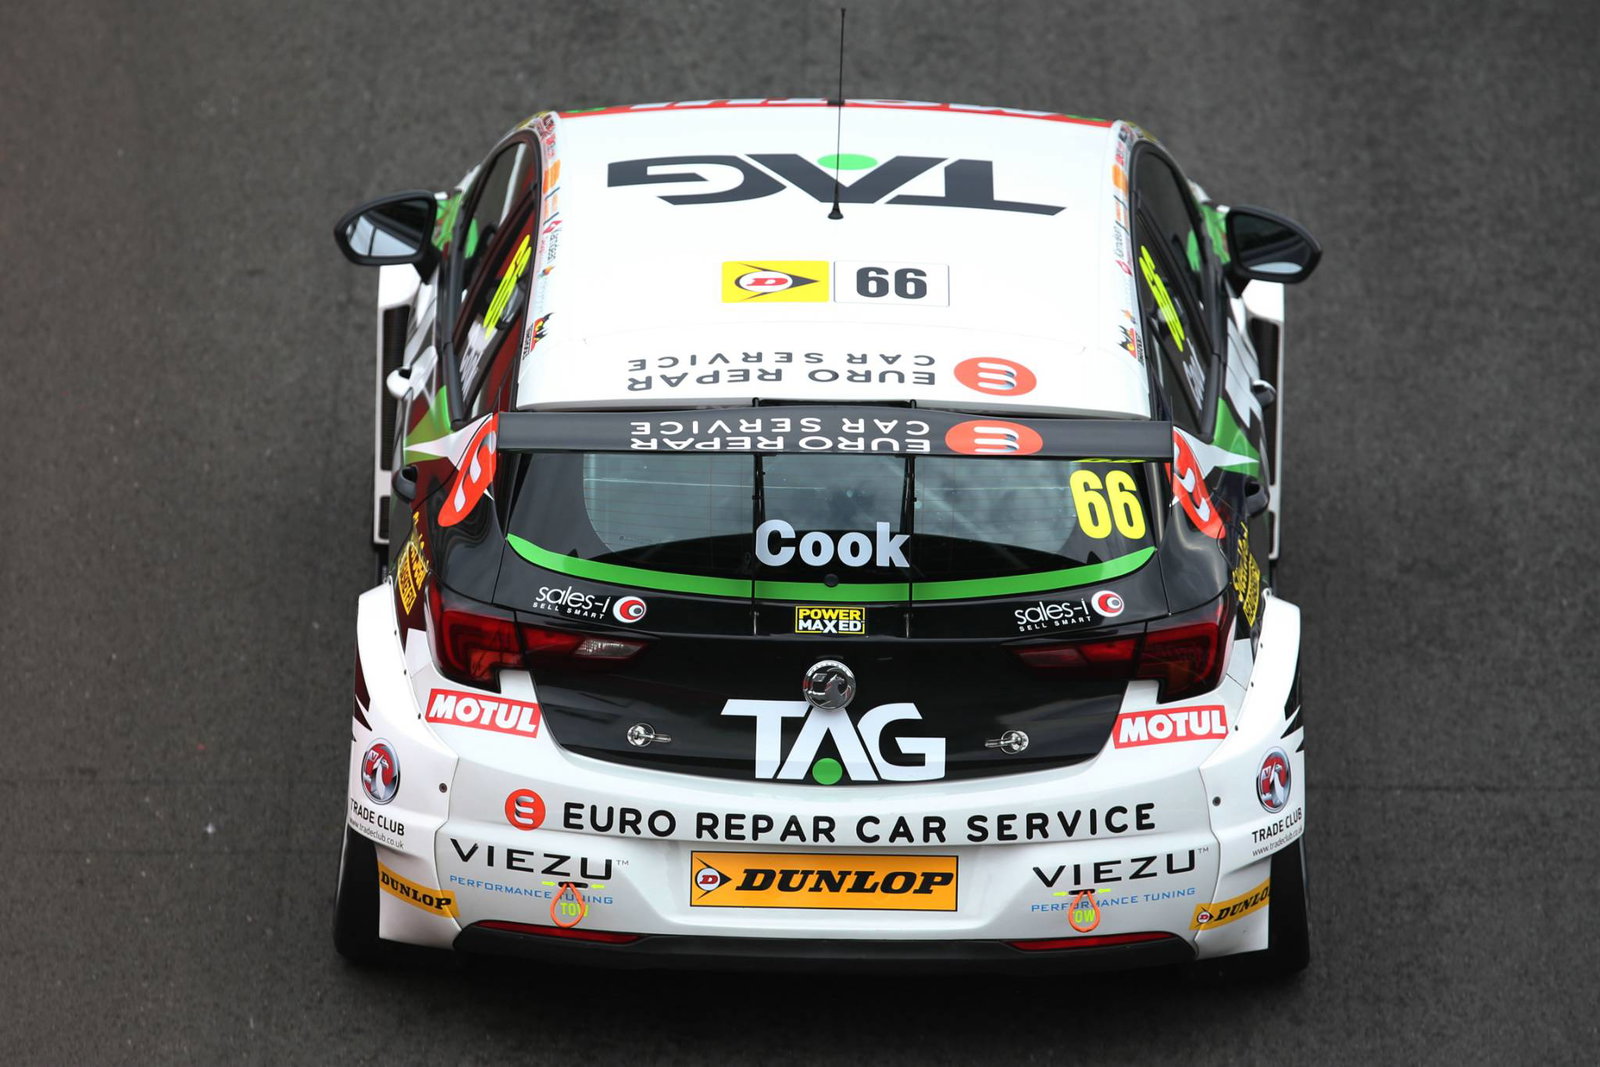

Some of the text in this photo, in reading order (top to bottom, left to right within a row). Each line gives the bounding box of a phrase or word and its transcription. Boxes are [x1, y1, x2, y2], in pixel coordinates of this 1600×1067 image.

[607, 153, 1067, 216] TAG
[856, 266, 928, 300] 66
[628, 350, 936, 371] CAR SERVICE
[628, 368, 936, 392] EURO REPAR
[630, 417, 931, 435] CAR SERVICE
[629, 434, 931, 453] EURO REPAR
[1069, 470, 1146, 540] 66
[755, 519, 911, 569] Cook
[532, 602, 605, 620] SELL SMART
[798, 608, 862, 621] POWER
[798, 619, 862, 634] MAXED
[1019, 616, 1092, 632] SELL SMART
[429, 693, 537, 734] MOTUL
[1118, 709, 1227, 743] MOTUL
[720, 699, 947, 786] TAG
[350, 798, 405, 837] TRADE CLUB
[563, 802, 1156, 843] EURO REPAR CAR SERVICE
[1251, 807, 1303, 844] TRADE CLUB
[449, 838, 613, 881] VIEZU
[1032, 849, 1196, 888] VIEZU
[380, 871, 453, 910] DUNLOP
[449, 874, 553, 900] PERFORMANCE
[735, 868, 955, 895] DUNLOP
[1143, 887, 1196, 901] TUNING
[1213, 886, 1270, 922] DUNLO
